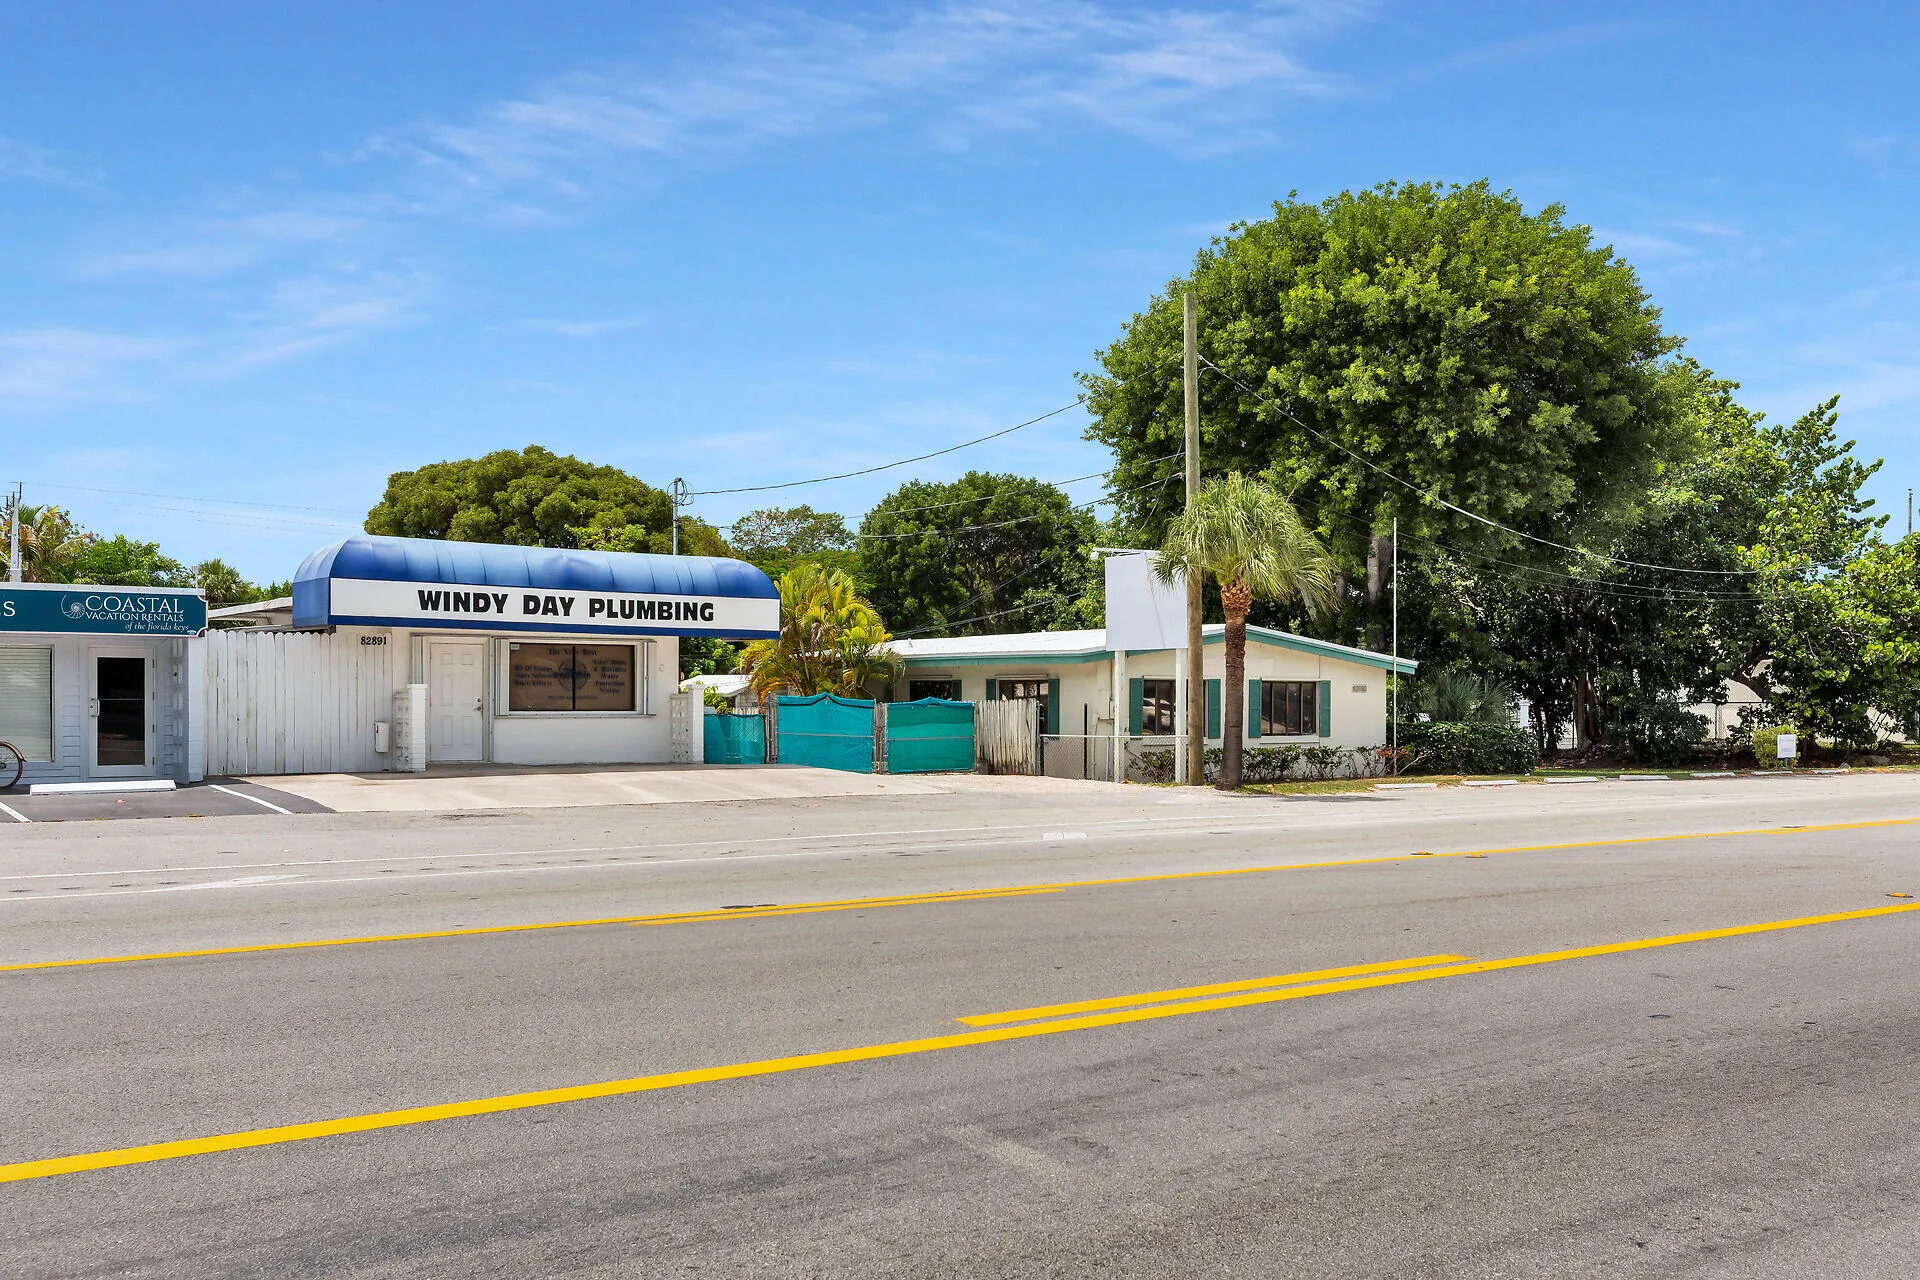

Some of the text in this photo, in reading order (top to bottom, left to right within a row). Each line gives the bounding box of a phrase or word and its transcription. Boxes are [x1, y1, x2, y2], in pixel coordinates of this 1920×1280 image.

[0, 600, 16, 617] S
[85, 595, 184, 614] COASTAL
[417, 589, 714, 622] WINDY DAY PLUMBING
[85, 611, 184, 622] VACATION RENTALS
[125, 621, 189, 633] of the florida keys
[360, 635, 387, 646] 82891
